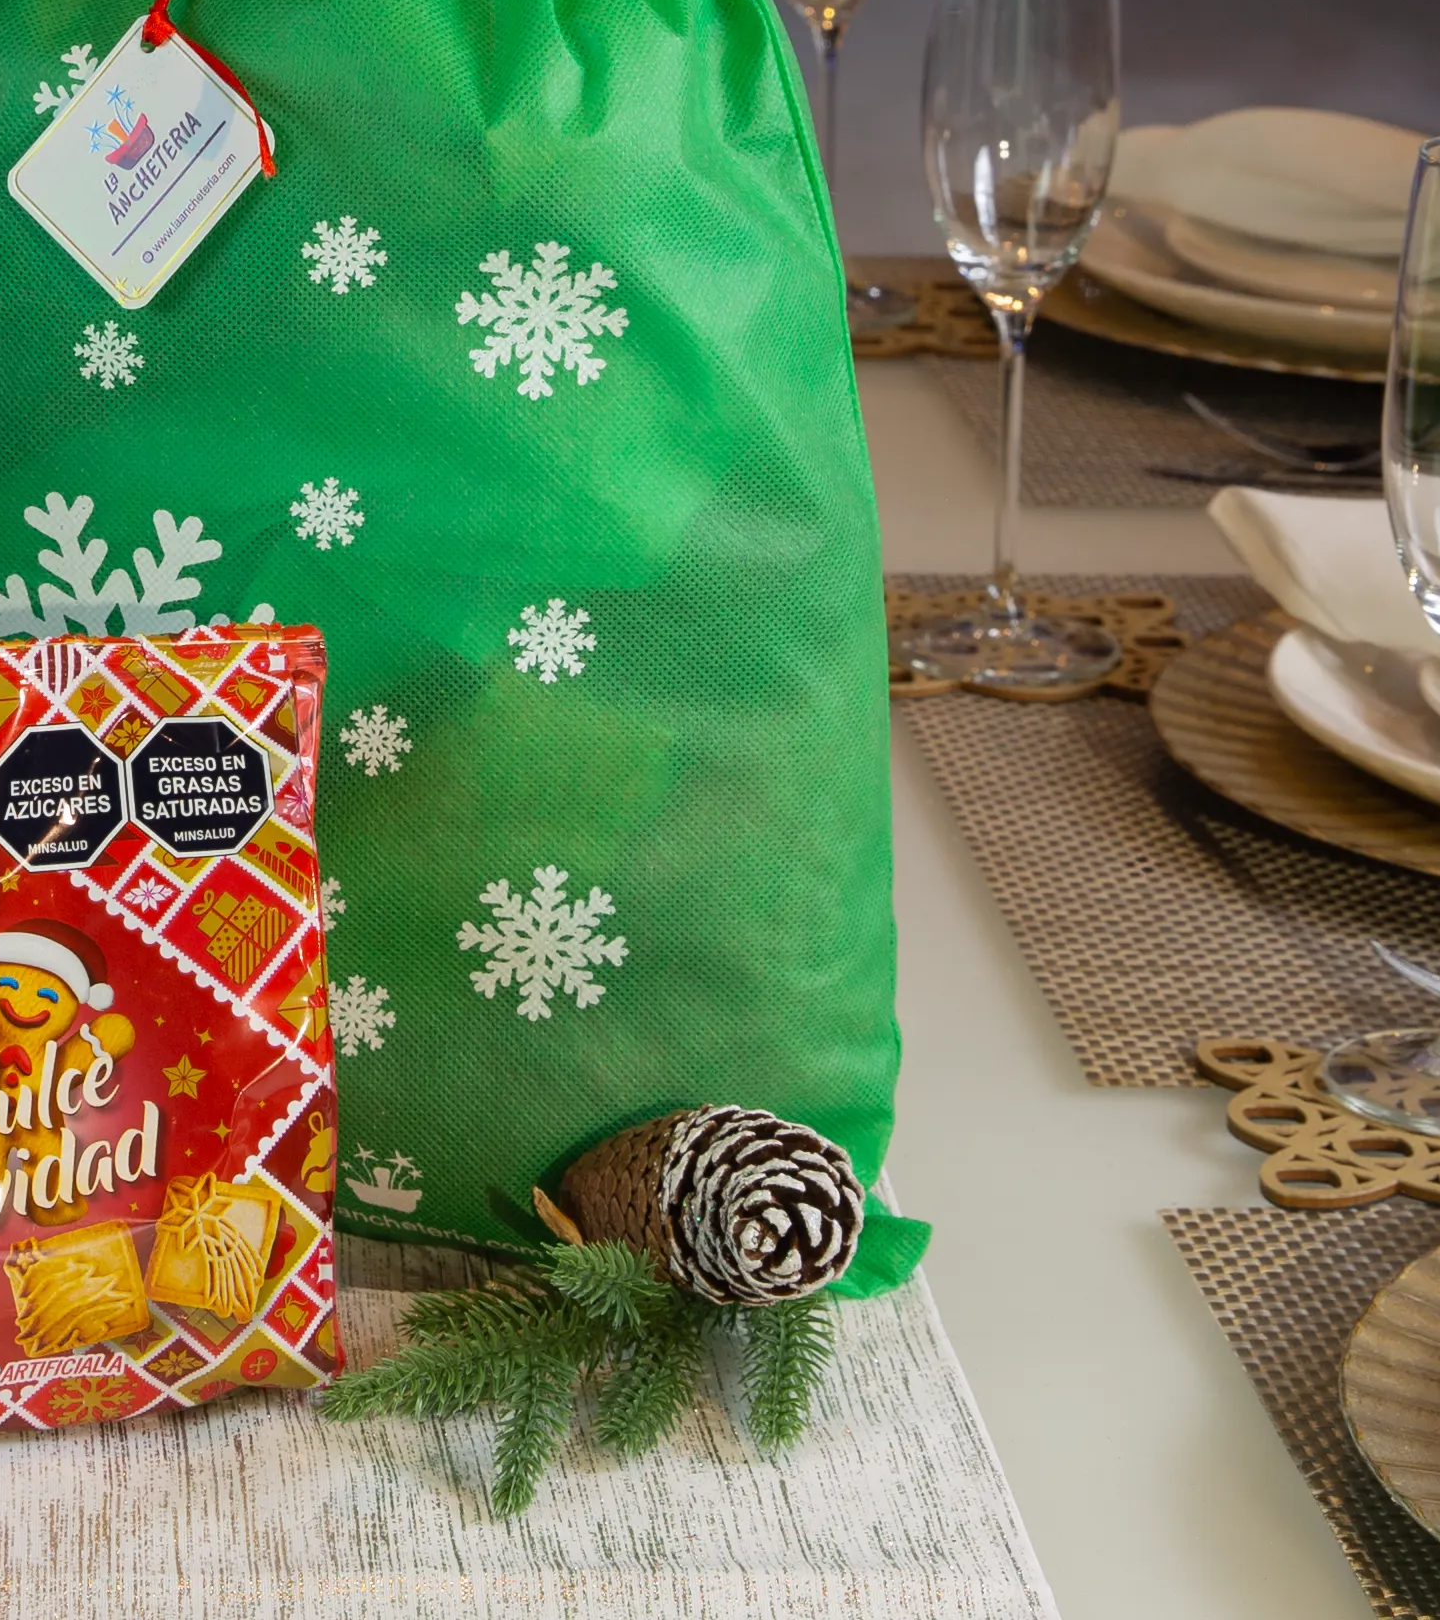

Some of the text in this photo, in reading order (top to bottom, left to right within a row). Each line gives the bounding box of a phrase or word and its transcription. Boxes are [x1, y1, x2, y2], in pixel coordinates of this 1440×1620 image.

[108, 111, 202, 225] ANCHETERIA
[104, 172, 119, 195] La
[152, 152, 237, 252] www.laancheteria.com
[149, 754, 246, 773] EXCESO EN
[10, 774, 102, 797] EXCESO EN
[158, 775, 242, 795] GRASAS
[4, 794, 111, 821] AZÚCARES
[142, 796, 262, 820] SATURADAS
[174, 827, 236, 843] MINSALUD
[27, 839, 88, 855] MINSALUD
[333, 1206, 545, 1260] ancheteria.com
[2, 1357, 103, 1383] ARTIFICIAL
[105, 1356, 122, 1374] A
